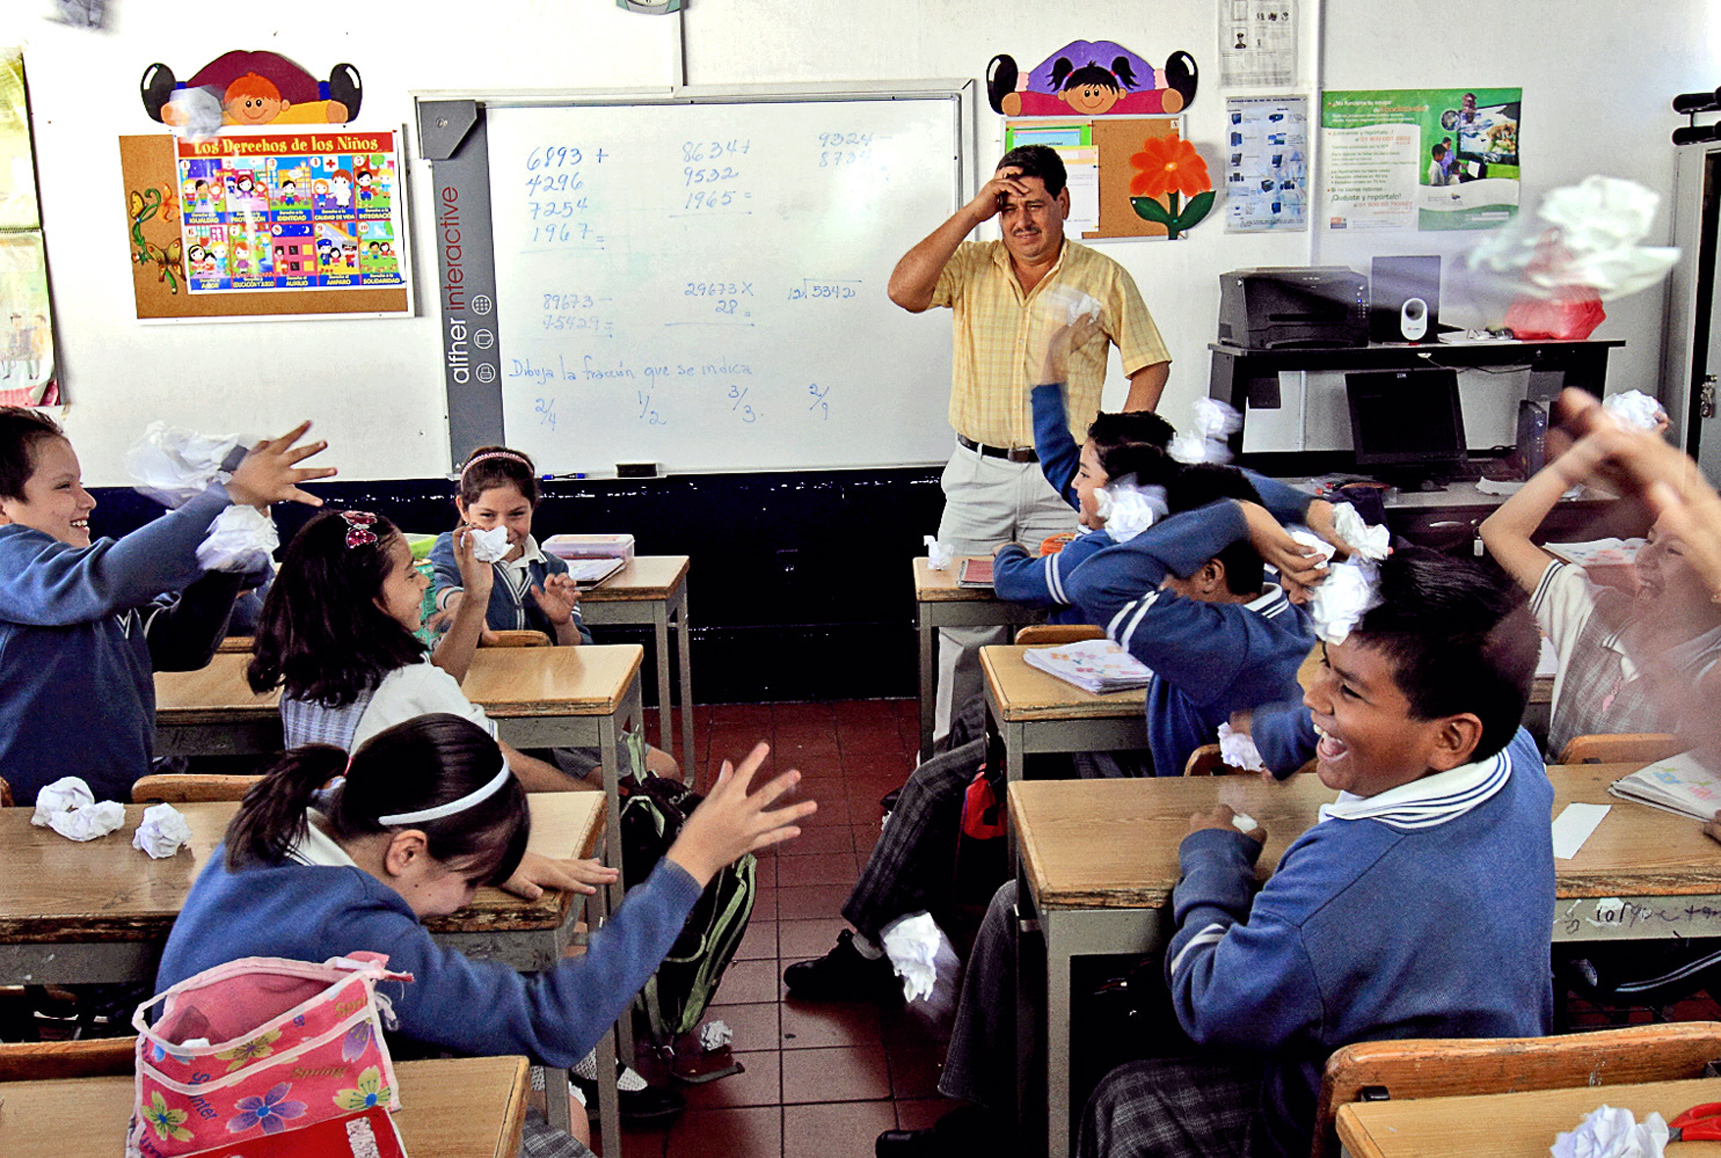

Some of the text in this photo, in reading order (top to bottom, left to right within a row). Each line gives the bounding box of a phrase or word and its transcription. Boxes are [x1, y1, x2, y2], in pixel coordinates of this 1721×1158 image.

[195, 136, 378, 154] Los Derechos de los Niños
[818, 132, 874, 148] 9324
[526, 146, 582, 171] 6893
[526, 172, 583, 197] 4296
[684, 166, 739, 187] 9532
[528, 197, 588, 220] 7254
[685, 190, 736, 210] 1965
[440, 186, 465, 310] interactive
[684, 282, 738, 296] 29673
[448, 317, 470, 384] alfher
[508, 358, 554, 385] Dibuja
[560, 355, 576, 381] la
[644, 364, 670, 388] que
[678, 364, 695, 378] se
[702, 356, 752, 376] indica
